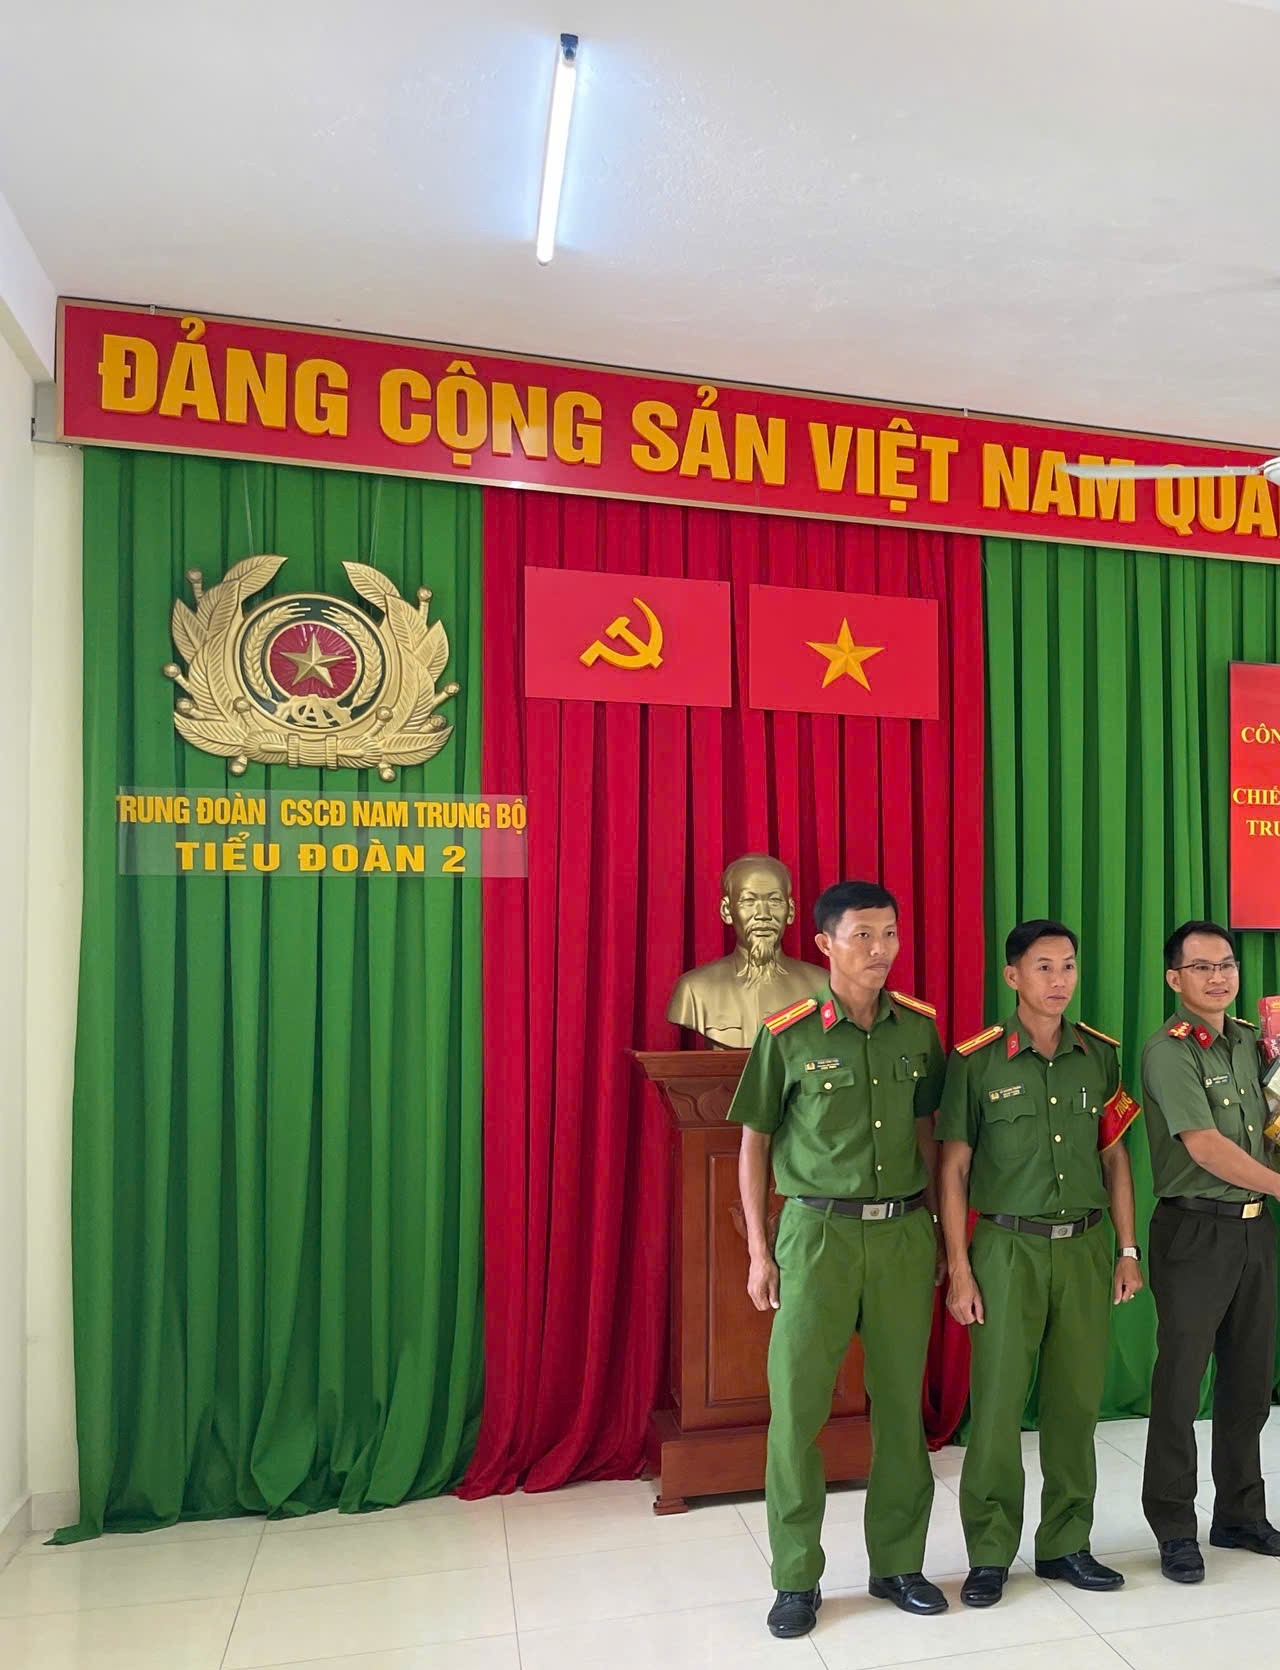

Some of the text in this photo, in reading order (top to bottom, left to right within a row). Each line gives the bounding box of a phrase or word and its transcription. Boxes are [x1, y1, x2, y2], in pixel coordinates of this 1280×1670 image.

[98, 317, 349, 438] ĐẢNG
[379, 360, 602, 467] CỘNG
[631, 385, 786, 487] SẢN
[809, 417, 959, 513] VIỆT
[981, 443, 1136, 523] NAM
[116, 792, 527, 835] RUNG ĐOÀN CSCĐ NAM TRUNG BỘ
[175, 831, 467, 873] TIỂU ĐOÀN 2
